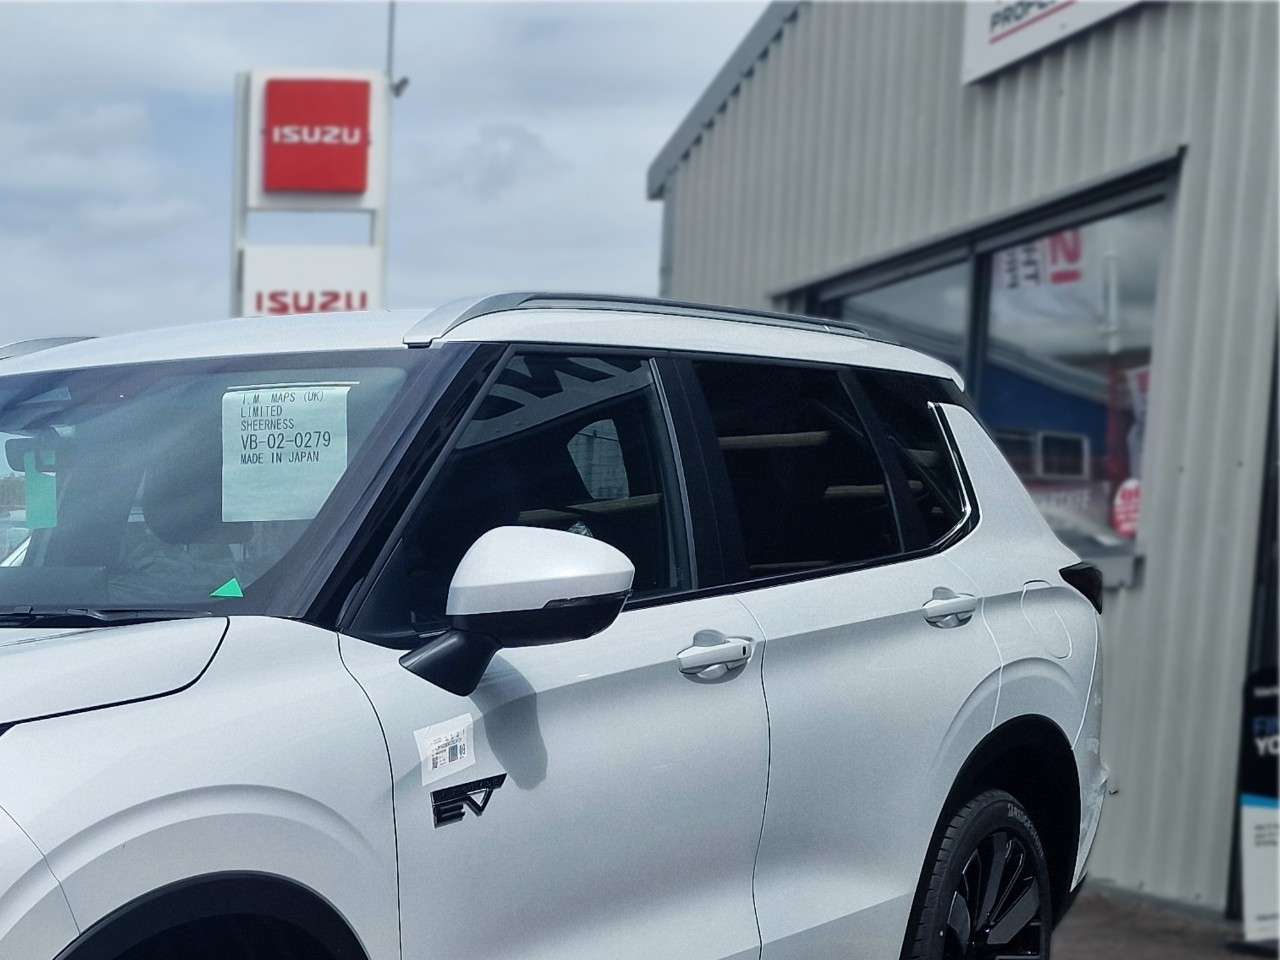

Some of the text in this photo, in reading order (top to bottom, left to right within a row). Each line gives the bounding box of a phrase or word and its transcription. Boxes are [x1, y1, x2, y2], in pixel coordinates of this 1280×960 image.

[272, 125, 361, 144] ISUZU
[256, 291, 368, 313] ISUZU
[271, 391, 296, 403] MAPS
[303, 391, 324, 403] (UK)
[240, 405, 283, 418] LIMITED
[240, 418, 295, 432] SHEERNESS
[240, 431, 331, 451] VB-02-0279
[240, 451, 320, 465] MADE IN JAPAN
